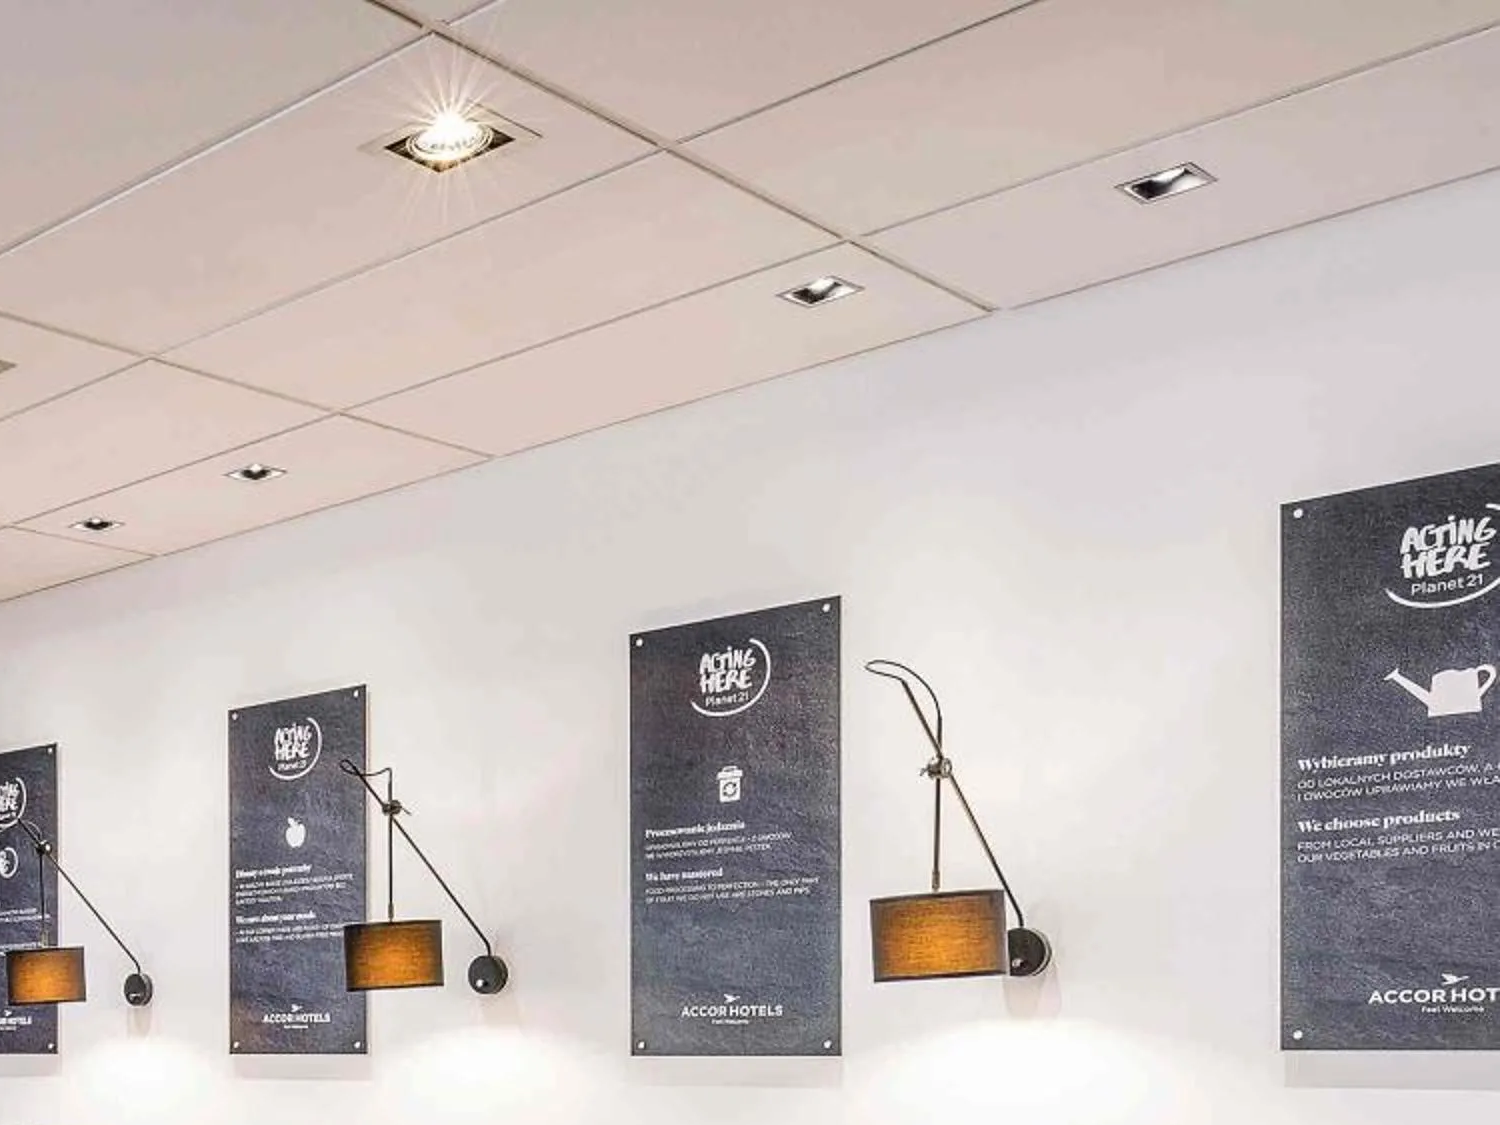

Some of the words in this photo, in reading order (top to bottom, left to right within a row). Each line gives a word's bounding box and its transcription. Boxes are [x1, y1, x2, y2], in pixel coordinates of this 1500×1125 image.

[1400, 542, 1491, 579] HERE
[1411, 577, 1464, 596] Planet
[1466, 573, 1484, 587] 21
[700, 667, 753, 694] HERE
[1298, 754, 1387, 773] Wybieramy
[1390, 743, 1471, 766] produkty
[1298, 818, 1322, 833] We
[1324, 817, 1381, 831] choose
[1383, 810, 1461, 829] products
[1446, 830, 1476, 840] AND
[1402, 844, 1430, 856] AND
